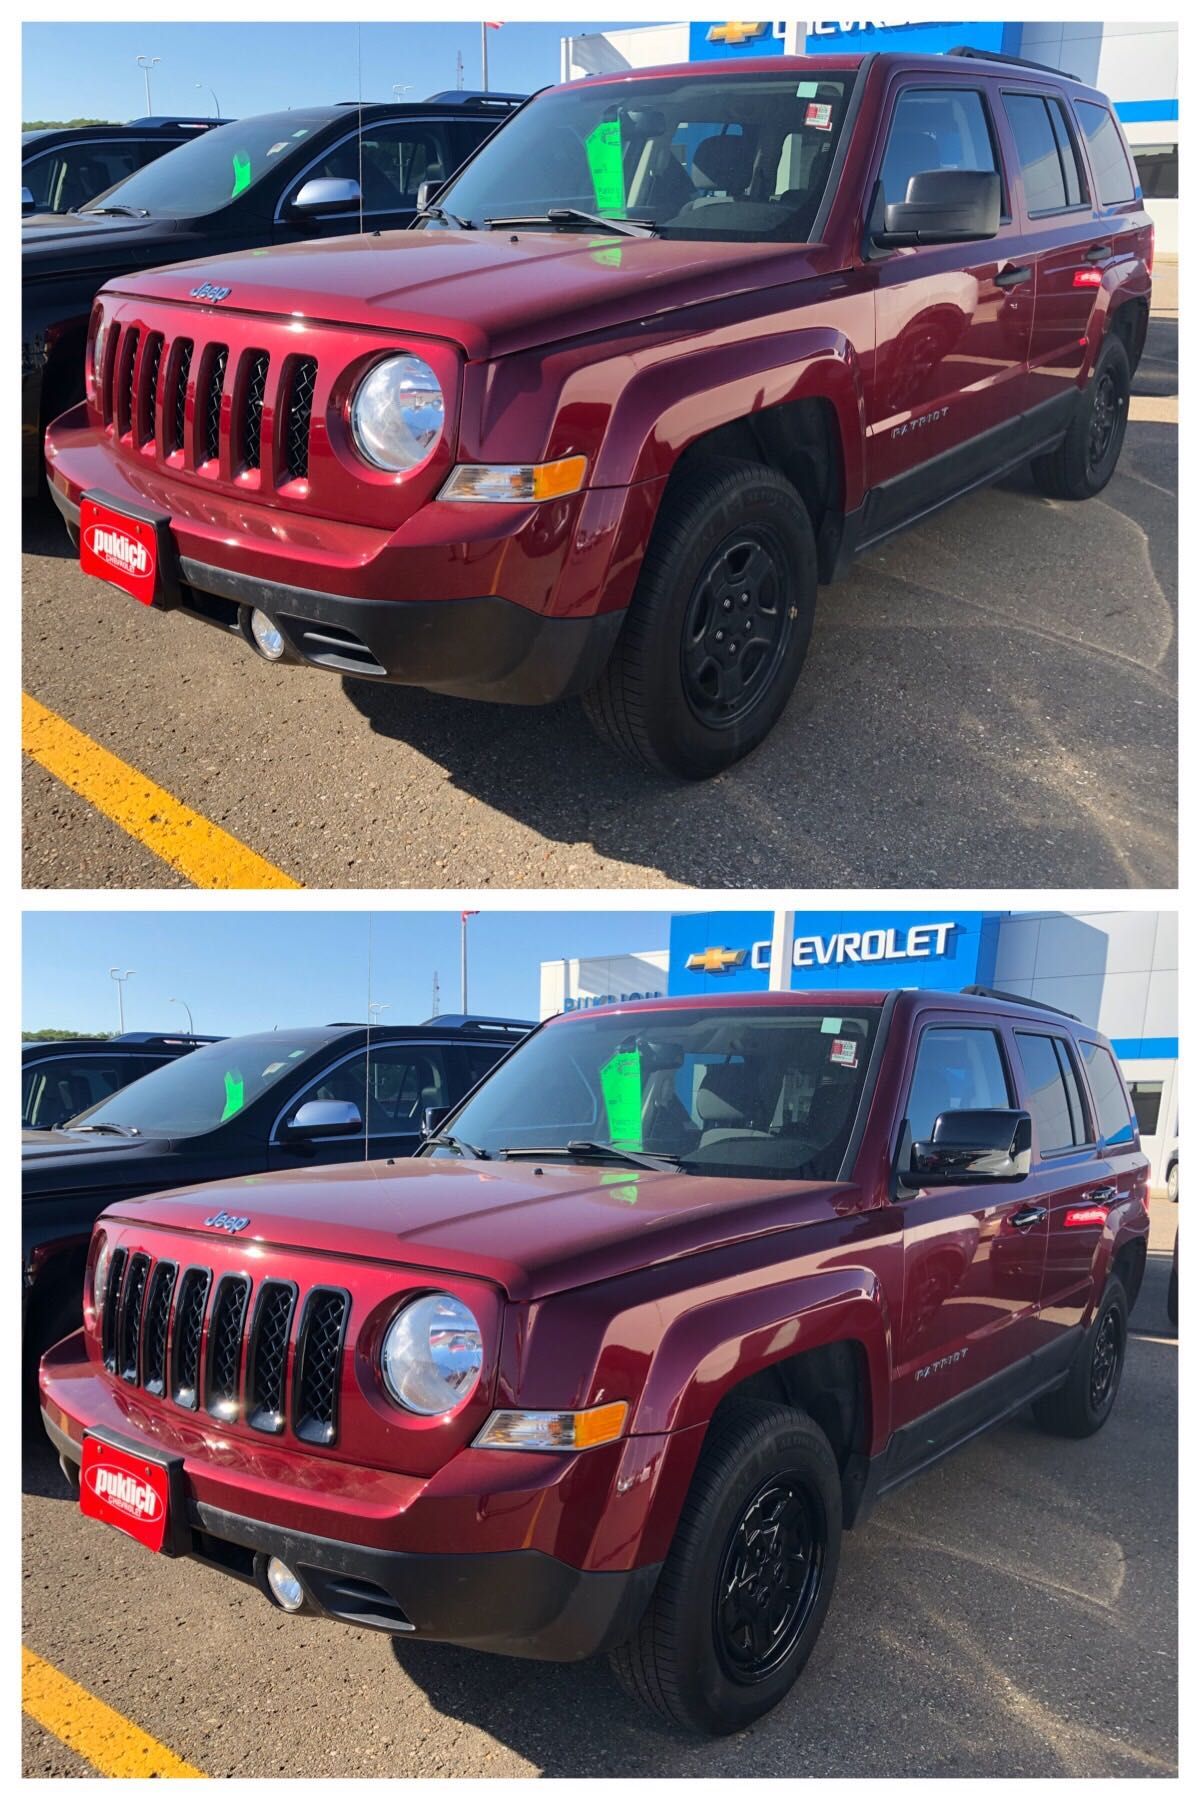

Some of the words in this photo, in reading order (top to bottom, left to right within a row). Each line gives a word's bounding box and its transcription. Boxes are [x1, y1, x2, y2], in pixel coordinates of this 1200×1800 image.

[191, 281, 231, 303] Jeep
[891, 406, 949, 439] PATRIOT
[94, 528, 147, 572] puklich
[751, 922, 955, 969] CEVROLET
[204, 1210, 250, 1233] Jeep
[915, 1347, 968, 1381] PATRIOT
[95, 1468, 156, 1516] puklich
